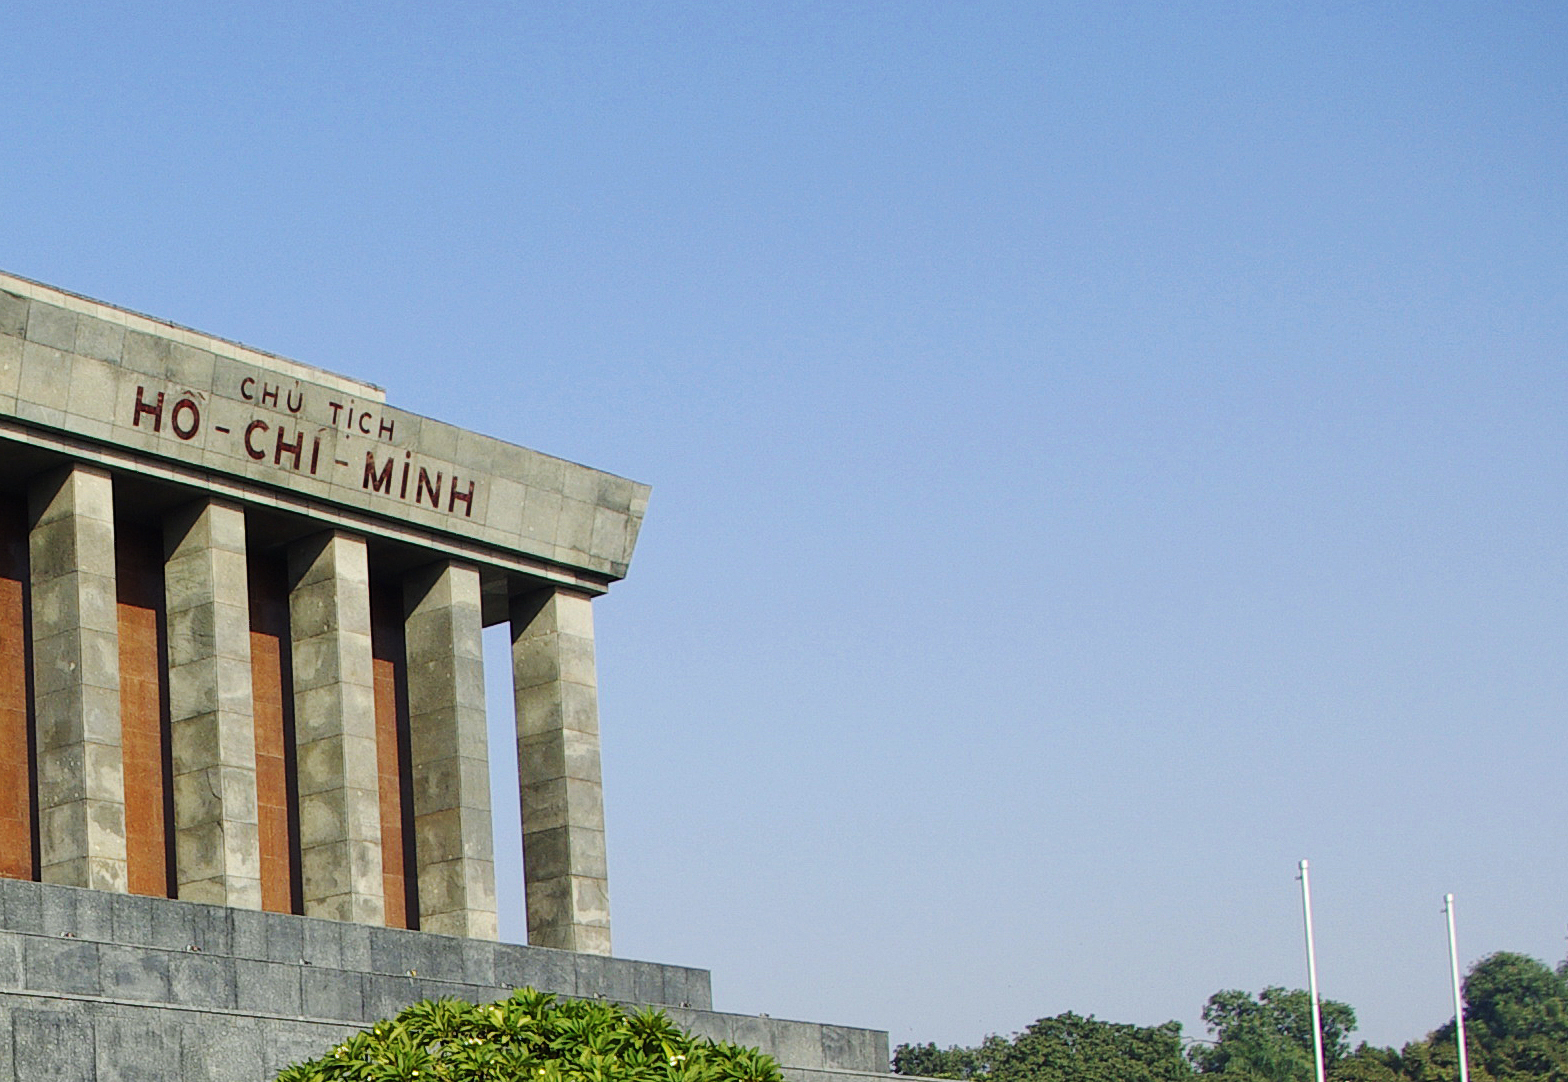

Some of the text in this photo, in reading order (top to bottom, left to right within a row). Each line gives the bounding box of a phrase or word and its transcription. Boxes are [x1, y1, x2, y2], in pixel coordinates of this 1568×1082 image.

[240, 376, 304, 414] CHỦ
[132, 385, 206, 441] HỒ
[244, 418, 328, 475] CHÍ
